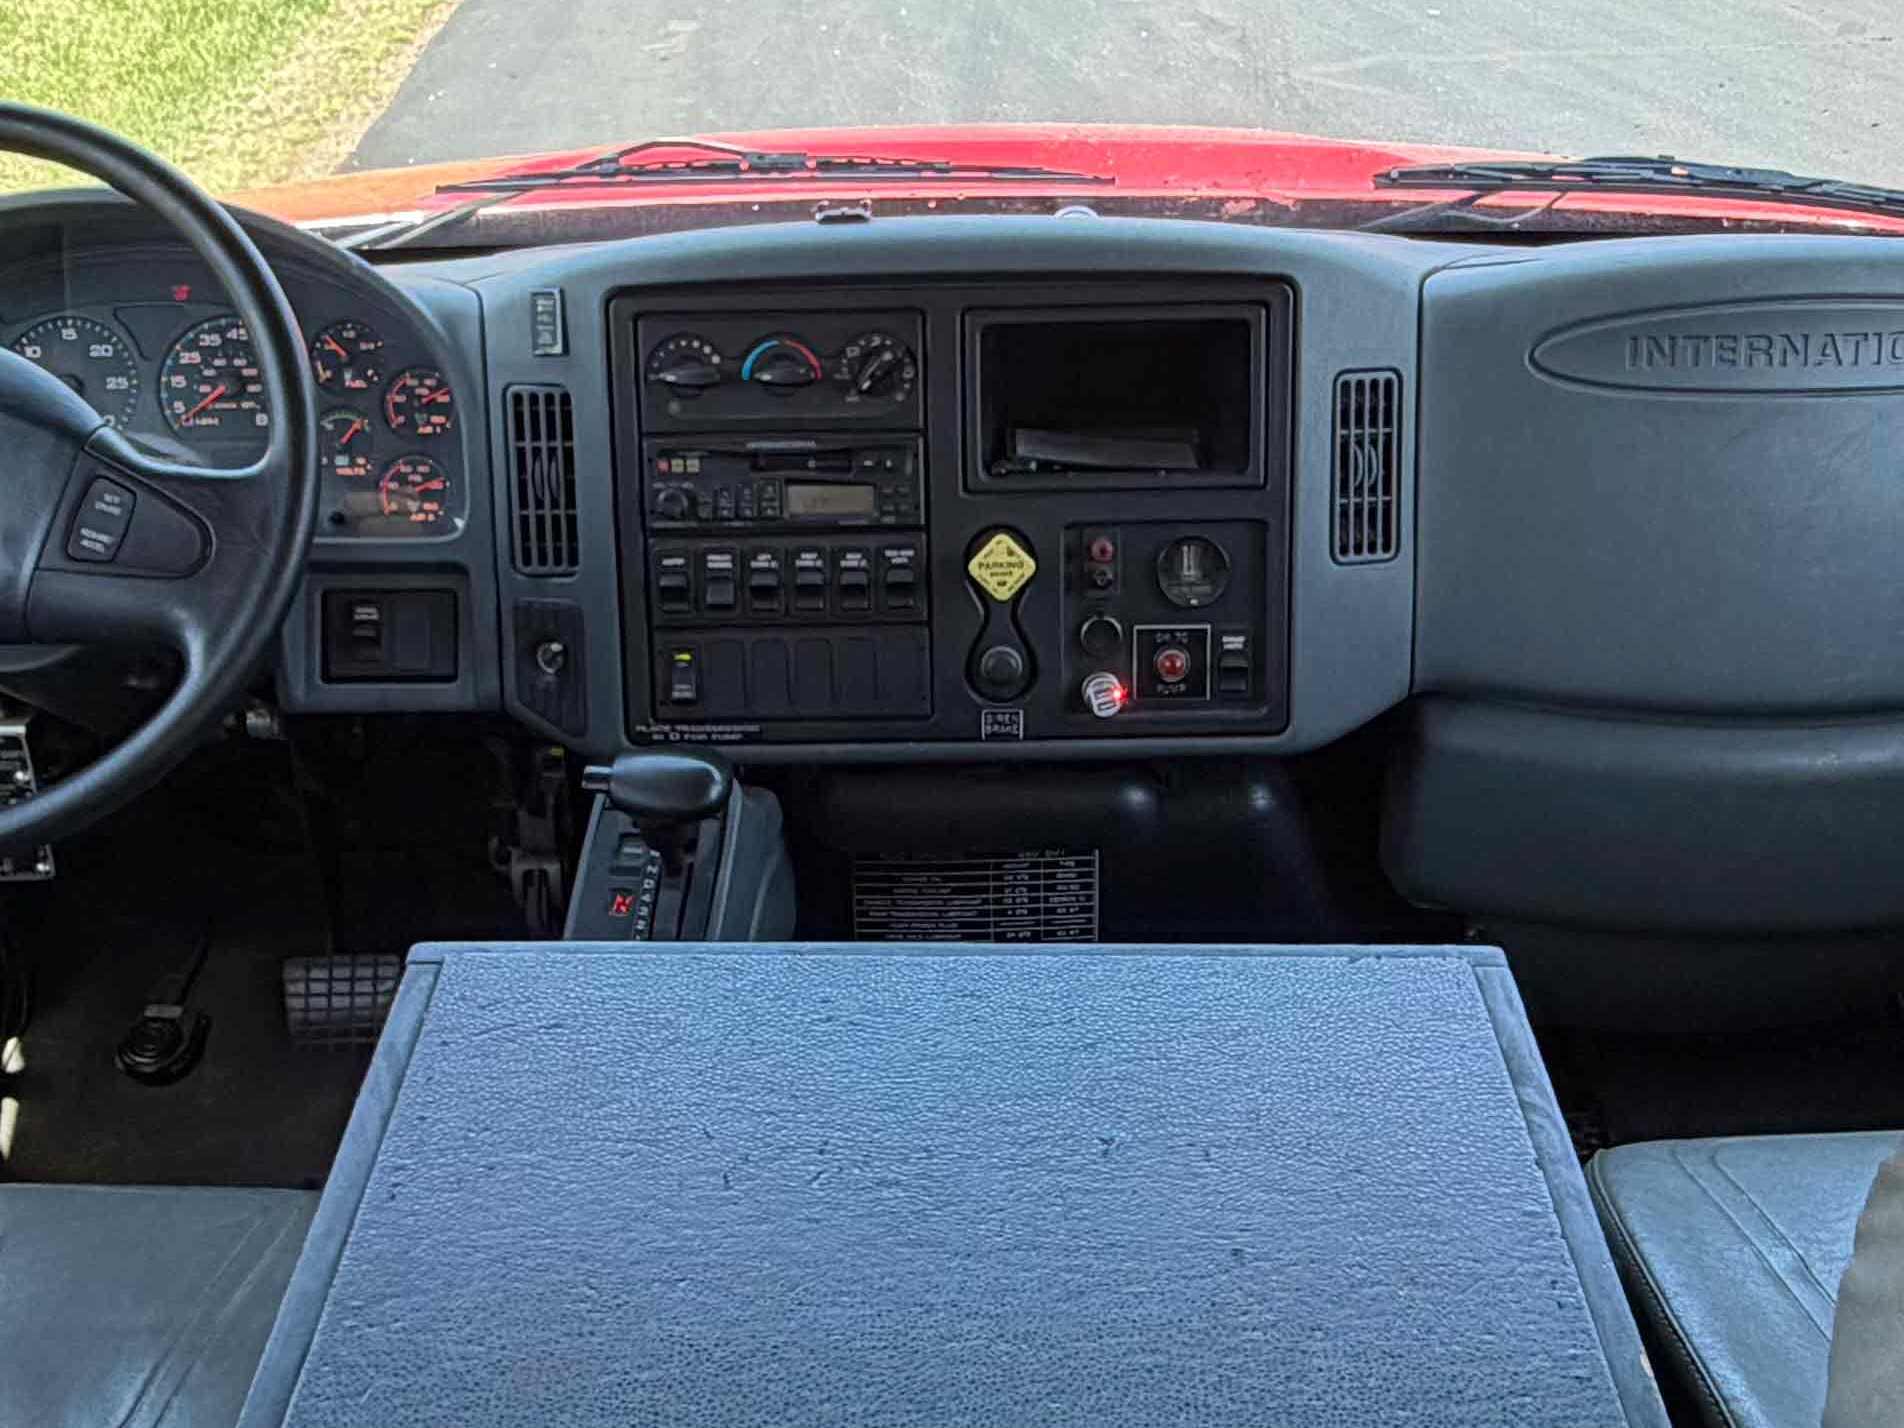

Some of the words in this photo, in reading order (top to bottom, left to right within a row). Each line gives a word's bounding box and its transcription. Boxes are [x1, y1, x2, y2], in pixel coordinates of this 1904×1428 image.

[61, 328, 79, 341] 15
[199, 334, 222, 347] 35
[227, 328, 248, 341] 45
[23, 346, 41, 359] 10
[89, 344, 113, 358] 20
[179, 351, 201, 365] 25
[106, 376, 129, 390] 25
[170, 375, 187, 388] 15
[173, 401, 185, 414] 5
